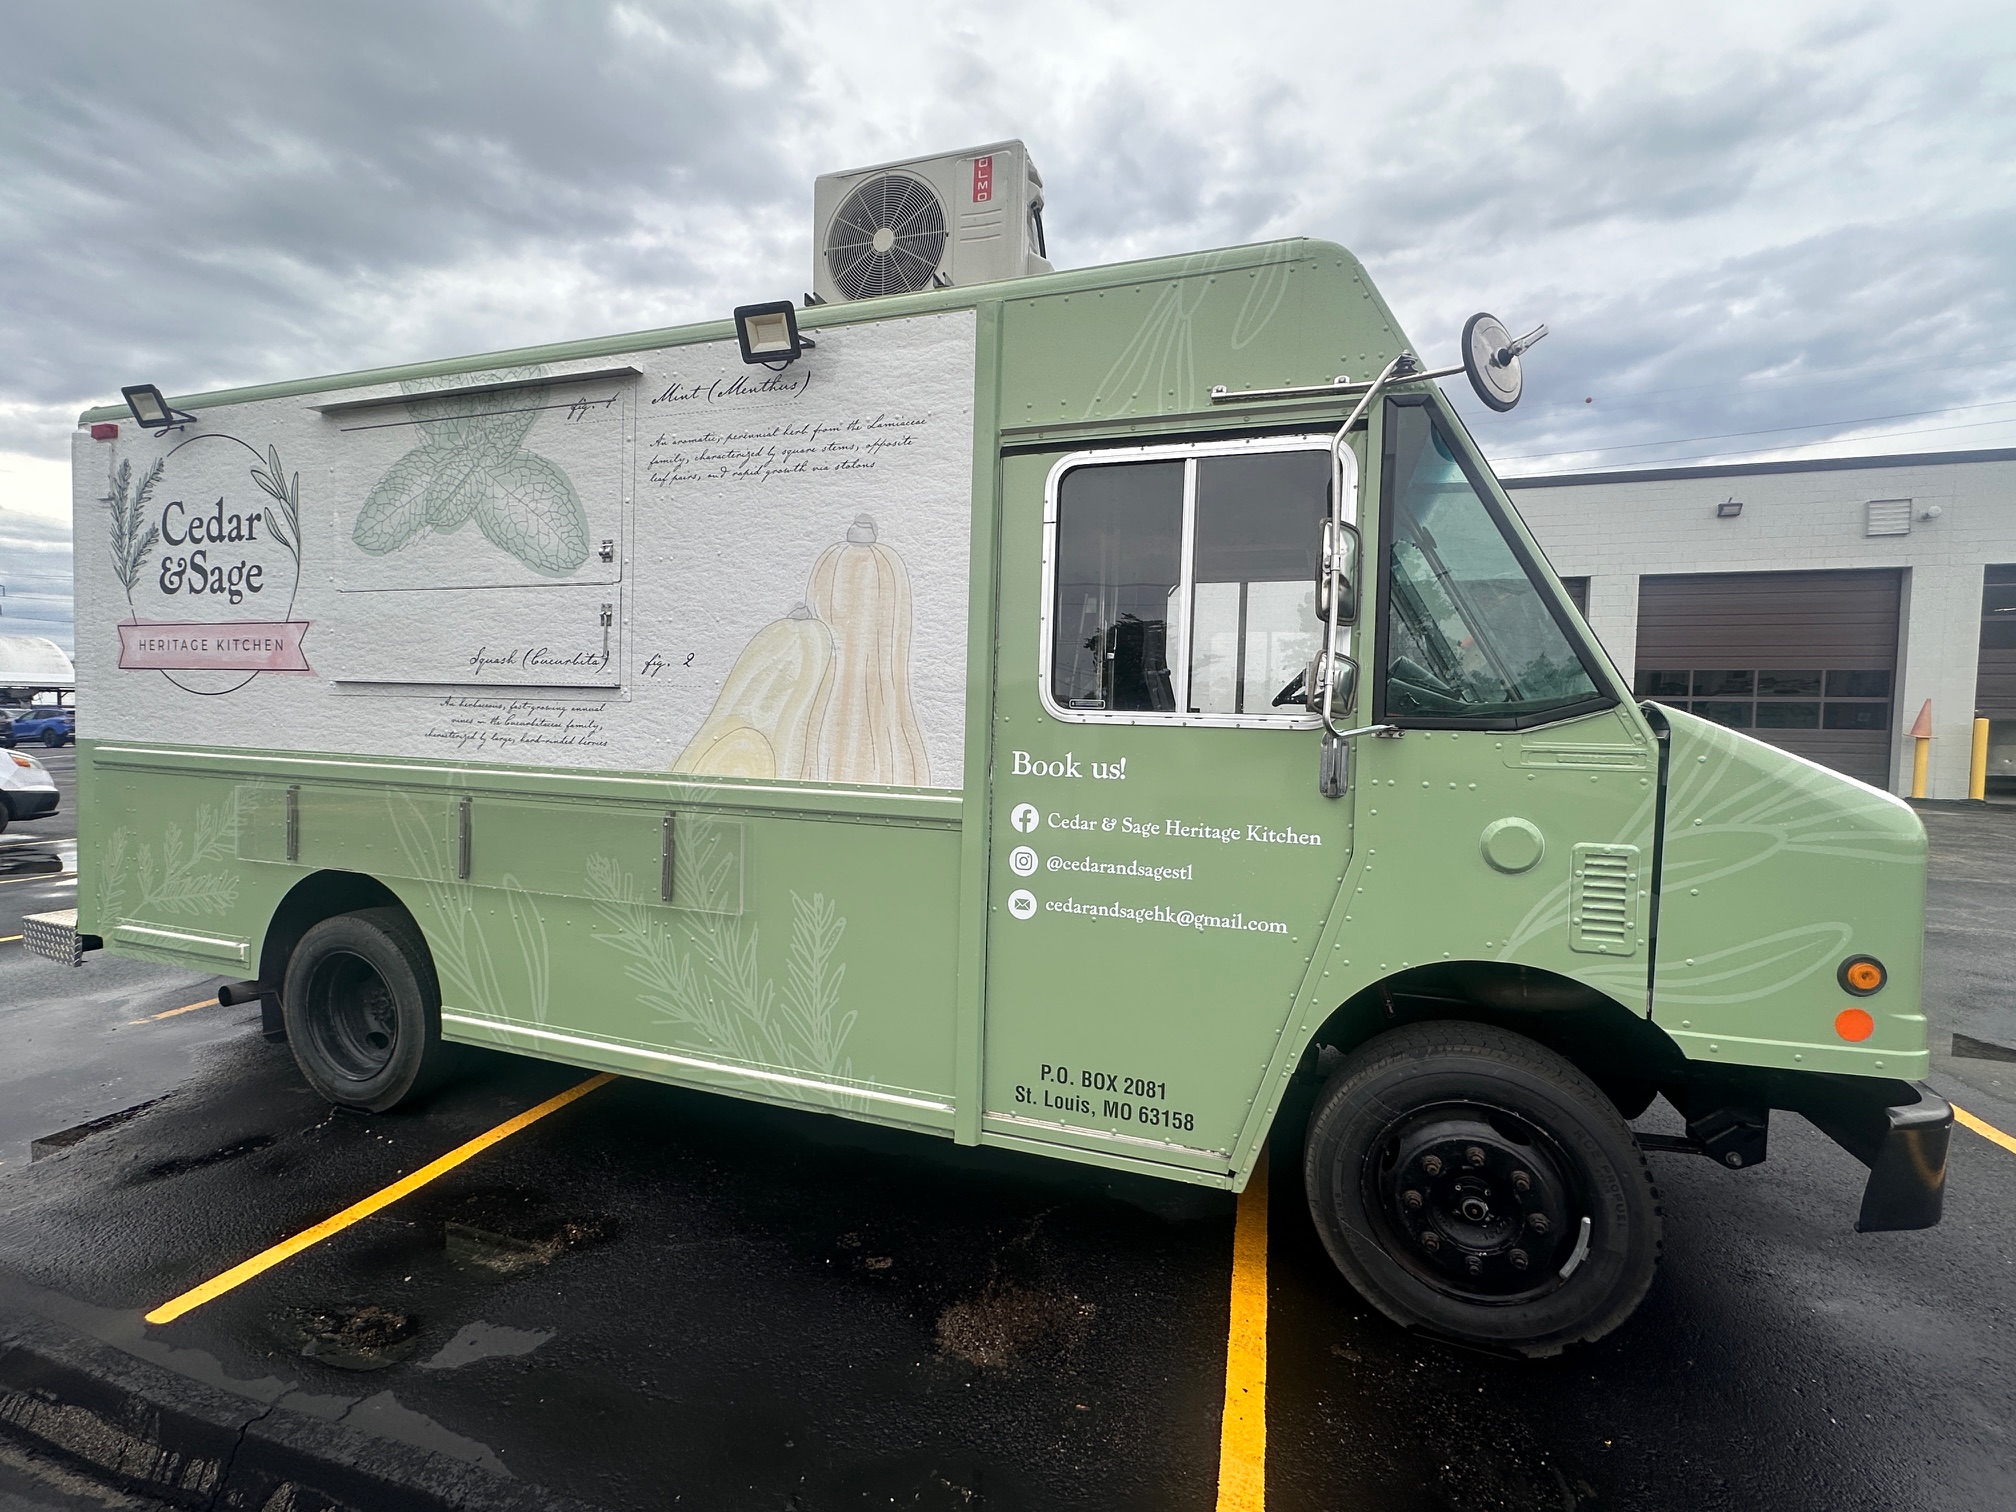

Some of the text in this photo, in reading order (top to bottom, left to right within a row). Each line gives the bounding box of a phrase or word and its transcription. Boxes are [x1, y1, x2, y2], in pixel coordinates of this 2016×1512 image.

[978, 158, 989, 201] OLMO
[651, 371, 811, 404] Mint (Menthus)
[650, 414, 927, 447] An aromatic, perennial herb from the Lamiaceae
[647, 435, 918, 472] family, characterized by square stems, opposite
[650, 458, 876, 487] leaf pairs, and rapid growth via stolons
[162, 497, 262, 546] Cedar
[138, 638, 284, 651] HERITAGE KITCHEN
[469, 647, 610, 676] Squash (Cucurbita)
[641, 652, 695, 677] fig. 2
[459, 697, 506, 710] herbaceous,
[507, 701, 567, 718] fast-growing
[571, 703, 606, 712] annual
[425, 728, 608, 750] characterized by large, hard-rinded berries
[451, 715, 473, 724] vines
[477, 714, 486, 724] in
[490, 715, 501, 725] the
[564, 719, 603, 737] family,
[1012, 751, 1127, 779] Book us!
[1047, 812, 1322, 846] Cedar & Sage Heritage Kitchen
[1046, 856, 1193, 881] @cedarandsagestl
[1045, 898, 1288, 934] cedarandsagehk@gmail.com
[1041, 1064, 1166, 1100] P.O. BOX 2081
[1015, 1085, 1194, 1131] St. Louis, MO 63158
